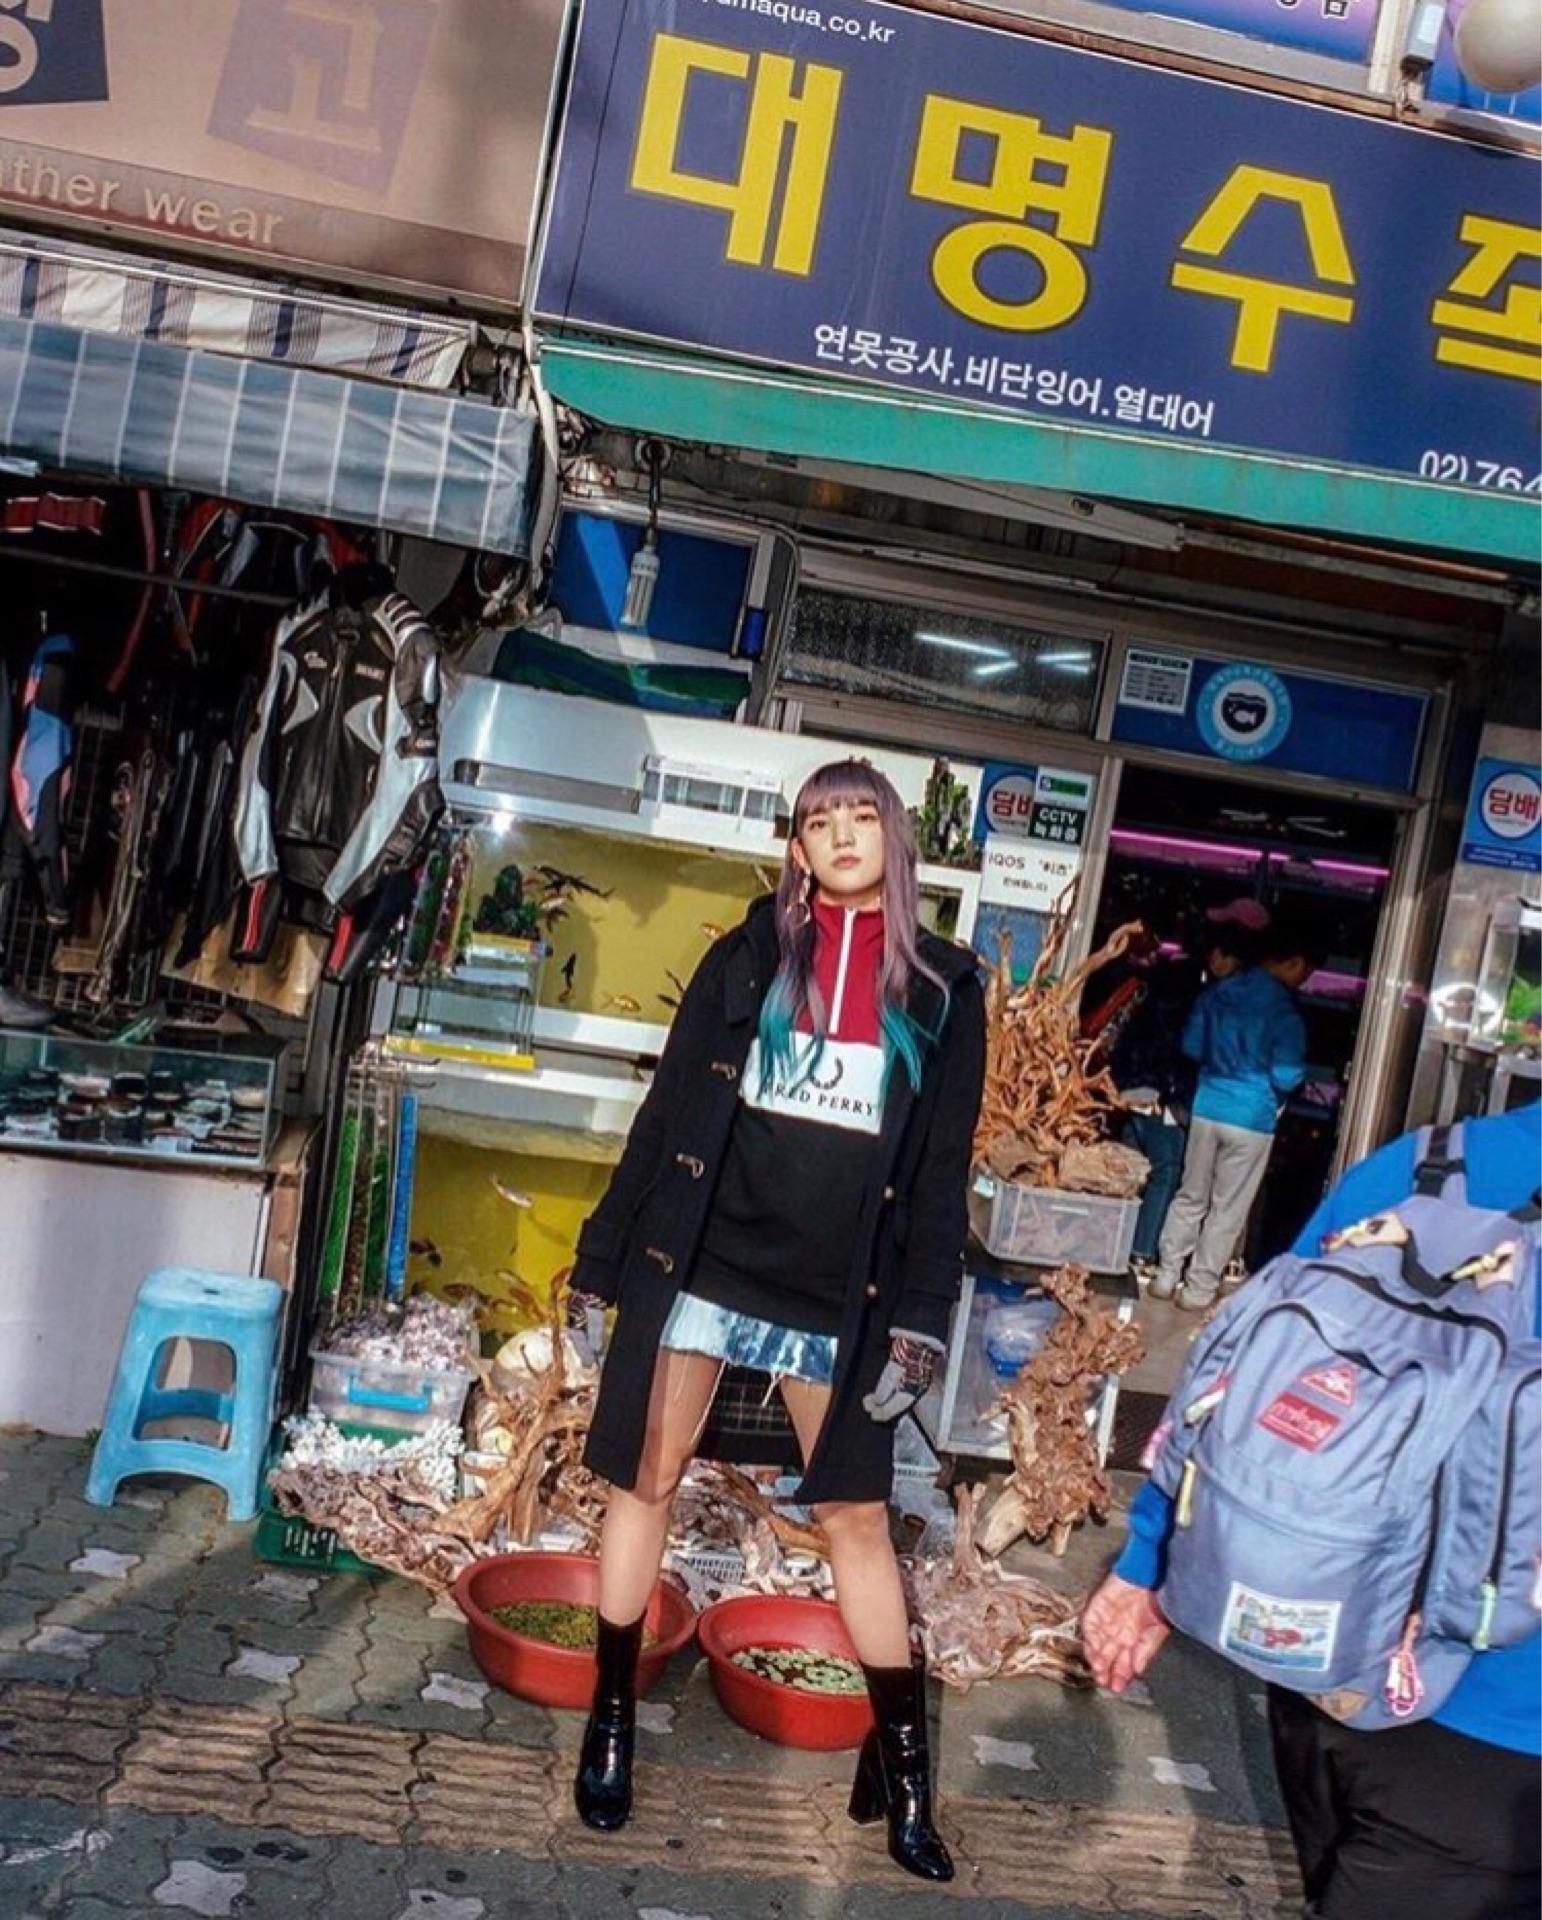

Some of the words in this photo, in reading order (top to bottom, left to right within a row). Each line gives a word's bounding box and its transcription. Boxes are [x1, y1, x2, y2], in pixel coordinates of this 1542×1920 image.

[0, 155, 120, 211] ther
[144, 187, 283, 244] wear
[1039, 806, 1078, 826] CCTV
[1488, 788, 1539, 821] 담배
[988, 851, 1026, 870] IQOS
[818, 1093, 874, 1117] PERRY
